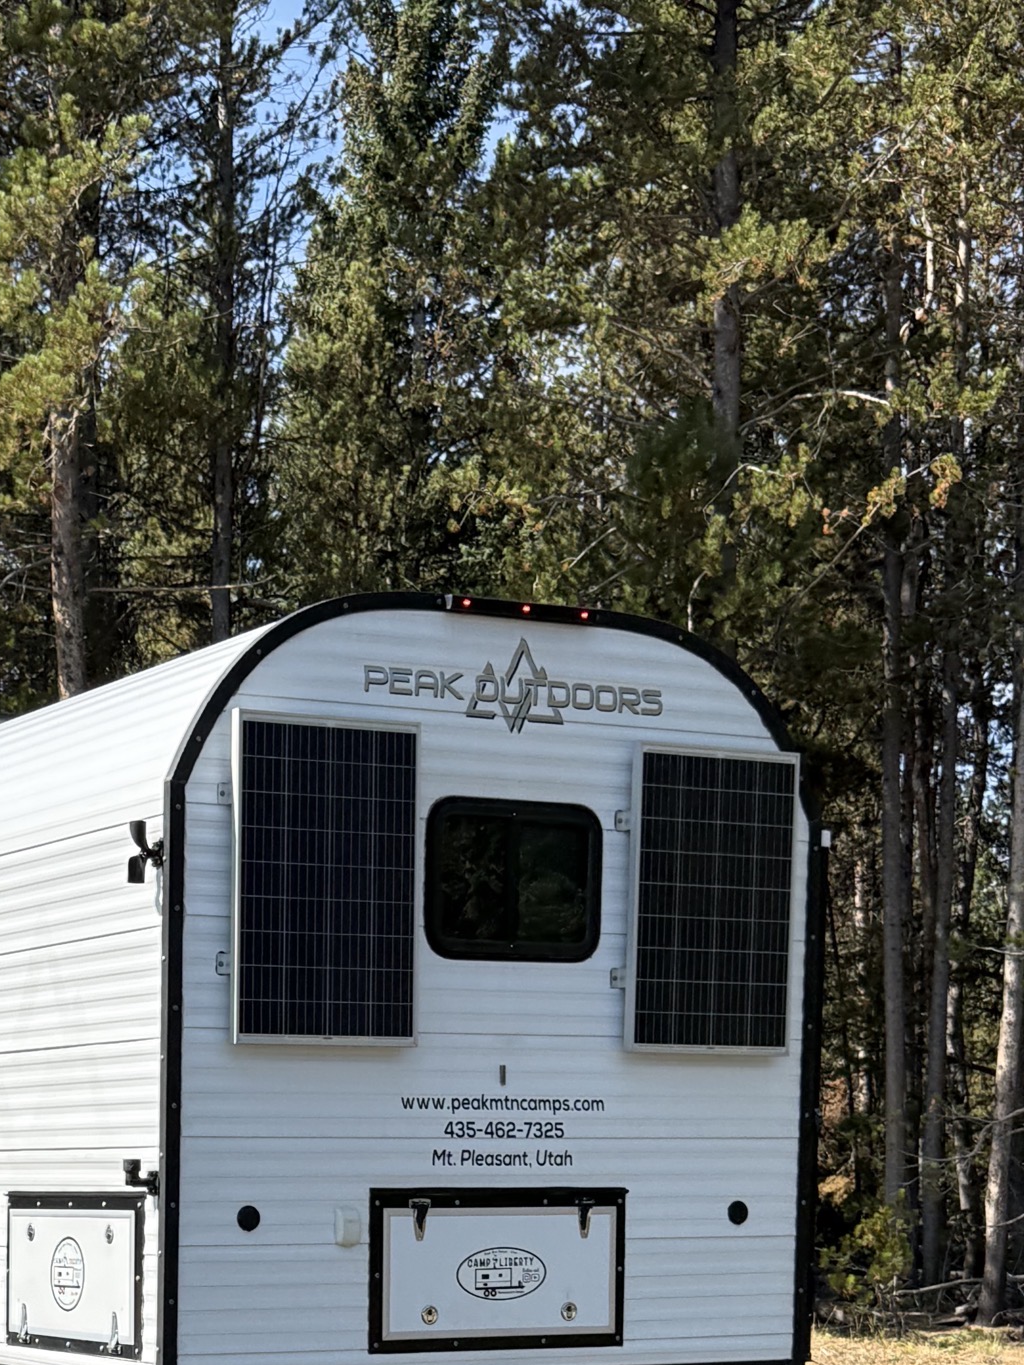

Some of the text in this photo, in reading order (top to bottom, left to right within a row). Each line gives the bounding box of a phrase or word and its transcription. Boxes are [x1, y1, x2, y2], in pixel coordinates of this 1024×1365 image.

[363, 664, 663, 716] PEAK OUTDOORS
[401, 1094, 605, 1115] www.peakmtncamps.com
[444, 1121, 565, 1139] 435-462-7325
[432, 1149, 574, 1168] Mt. Pleasant, Utah
[467, 1257, 535, 1268] CAMP LIBERTY
